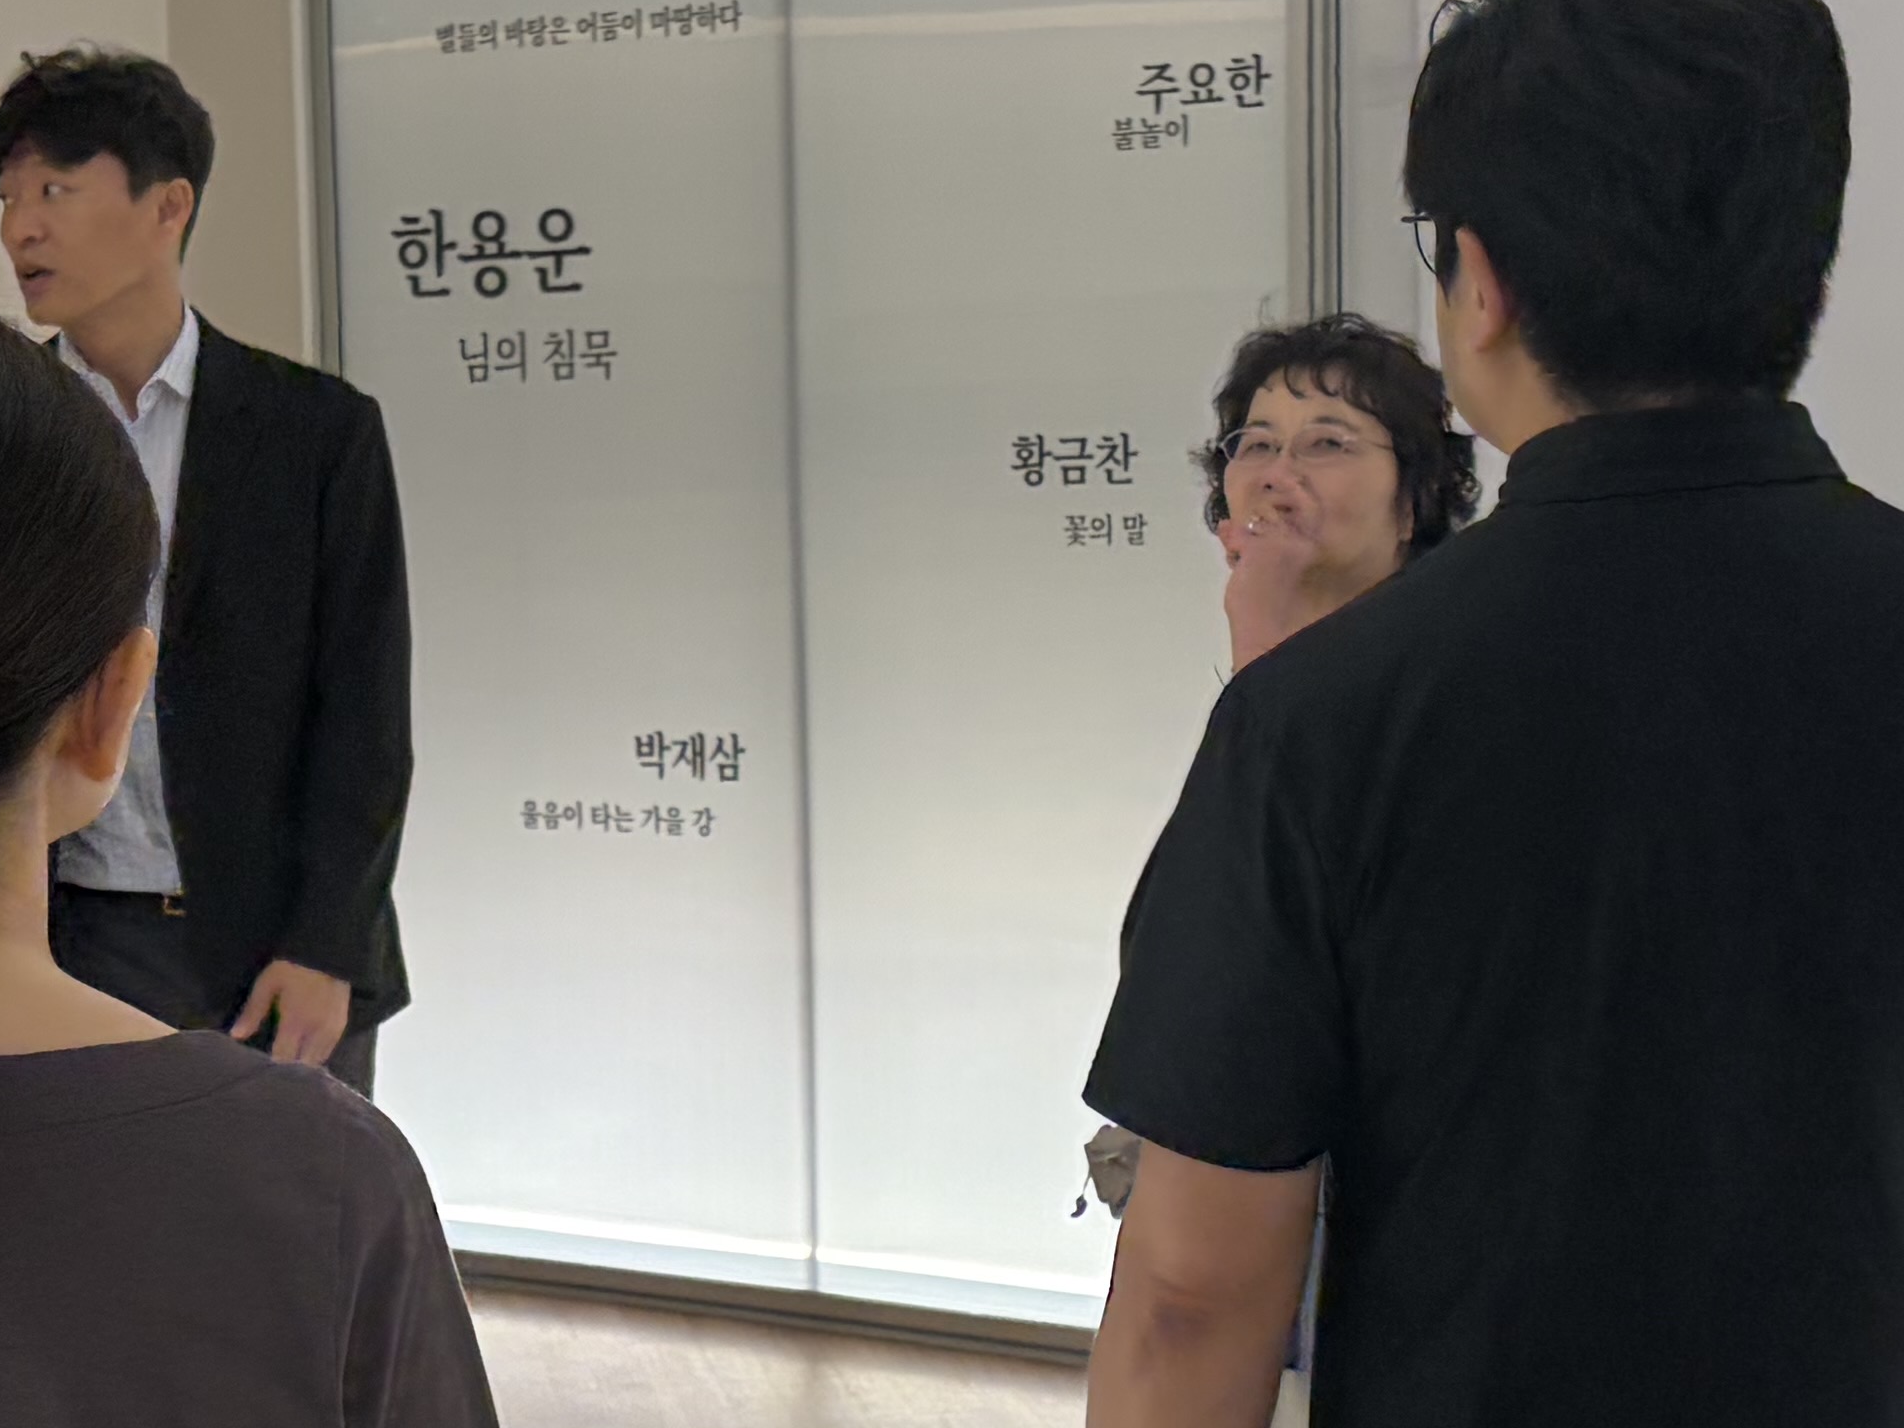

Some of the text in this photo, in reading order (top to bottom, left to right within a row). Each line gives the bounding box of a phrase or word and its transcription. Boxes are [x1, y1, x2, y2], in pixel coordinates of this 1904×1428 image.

[504, 15, 571, 48] 바탕은
[576, 8, 643, 43] 어둠이
[649, 0, 743, 37] 마땅하다
[1135, 53, 1272, 115] 주요한
[1111, 112, 1189, 152] 불놀이
[390, 207, 593, 299] 한용운
[458, 328, 618, 384] 님의 침묵
[1010, 431, 1139, 487] 황금찬
[1063, 512, 1148, 547] 꽃의 말
[634, 730, 746, 783] 박재삼
[590, 802, 635, 834] 타는
[641, 804, 685, 837] 가을
[692, 806, 716, 838] 강
